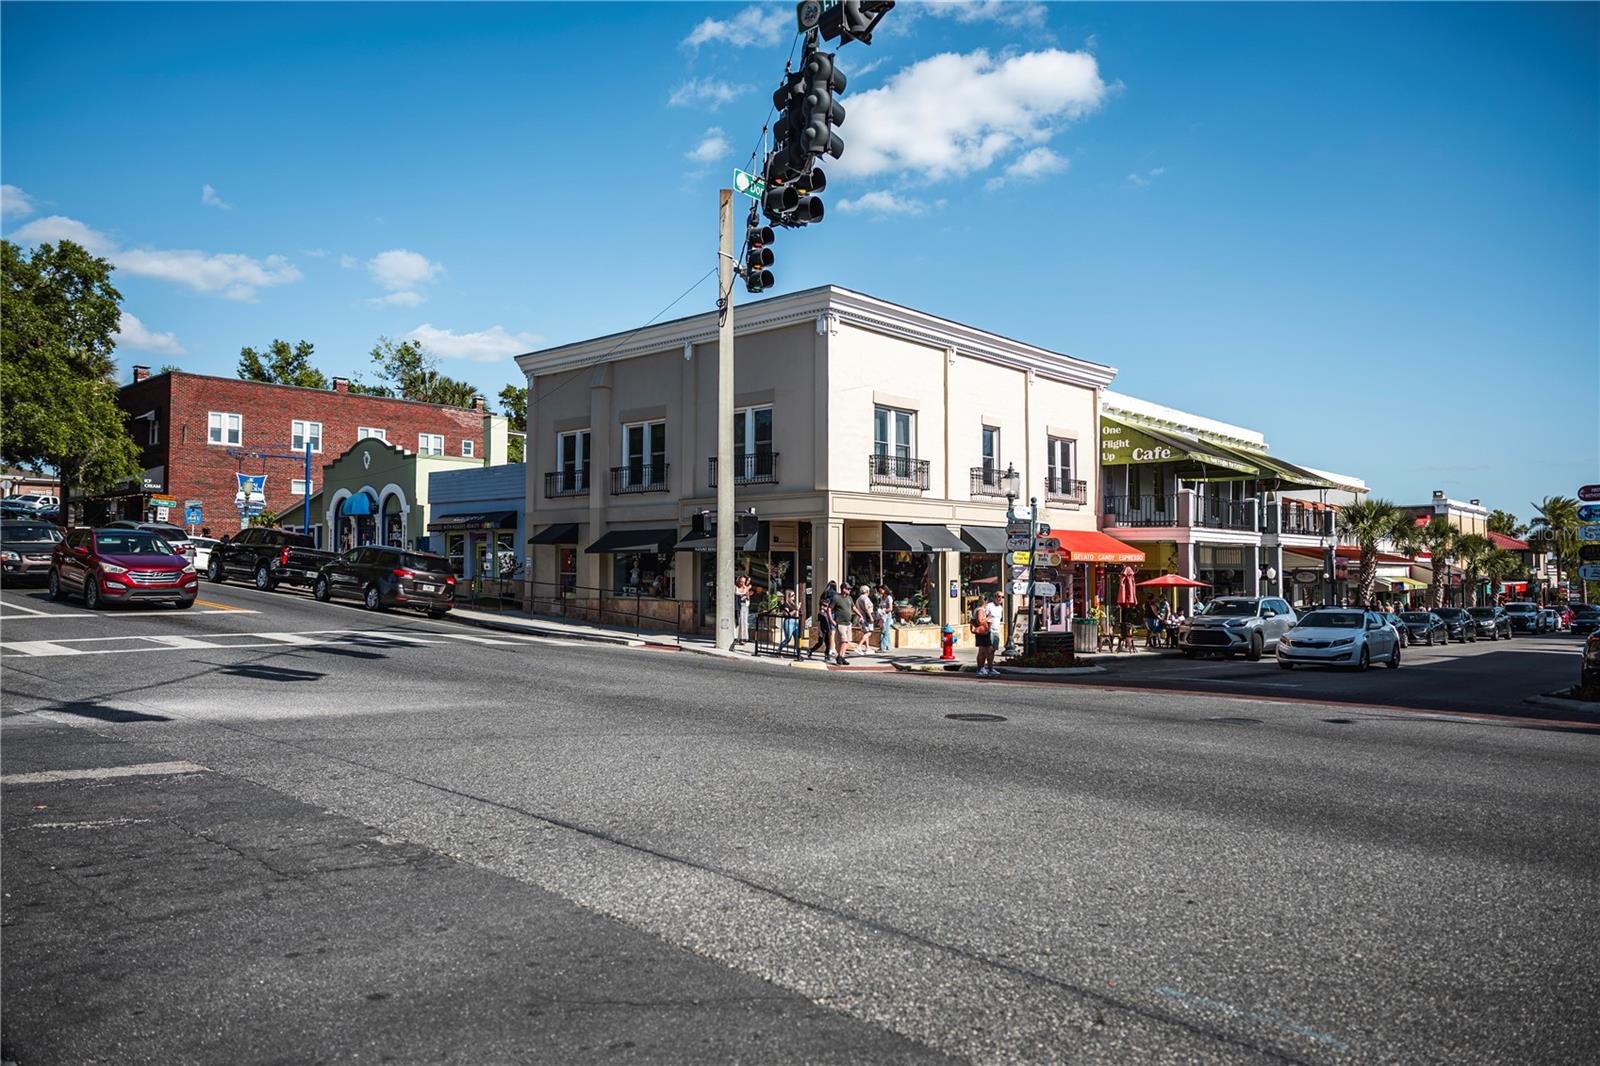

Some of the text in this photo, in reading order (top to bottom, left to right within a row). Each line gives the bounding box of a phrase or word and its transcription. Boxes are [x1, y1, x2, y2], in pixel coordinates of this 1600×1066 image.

[1102, 426, 1121, 435] One
[1102, 439, 1130, 450] Flight
[1102, 452, 1116, 462] Up
[1073, 552, 1095, 561] GELATO
[1098, 553, 1115, 561] CANDY
